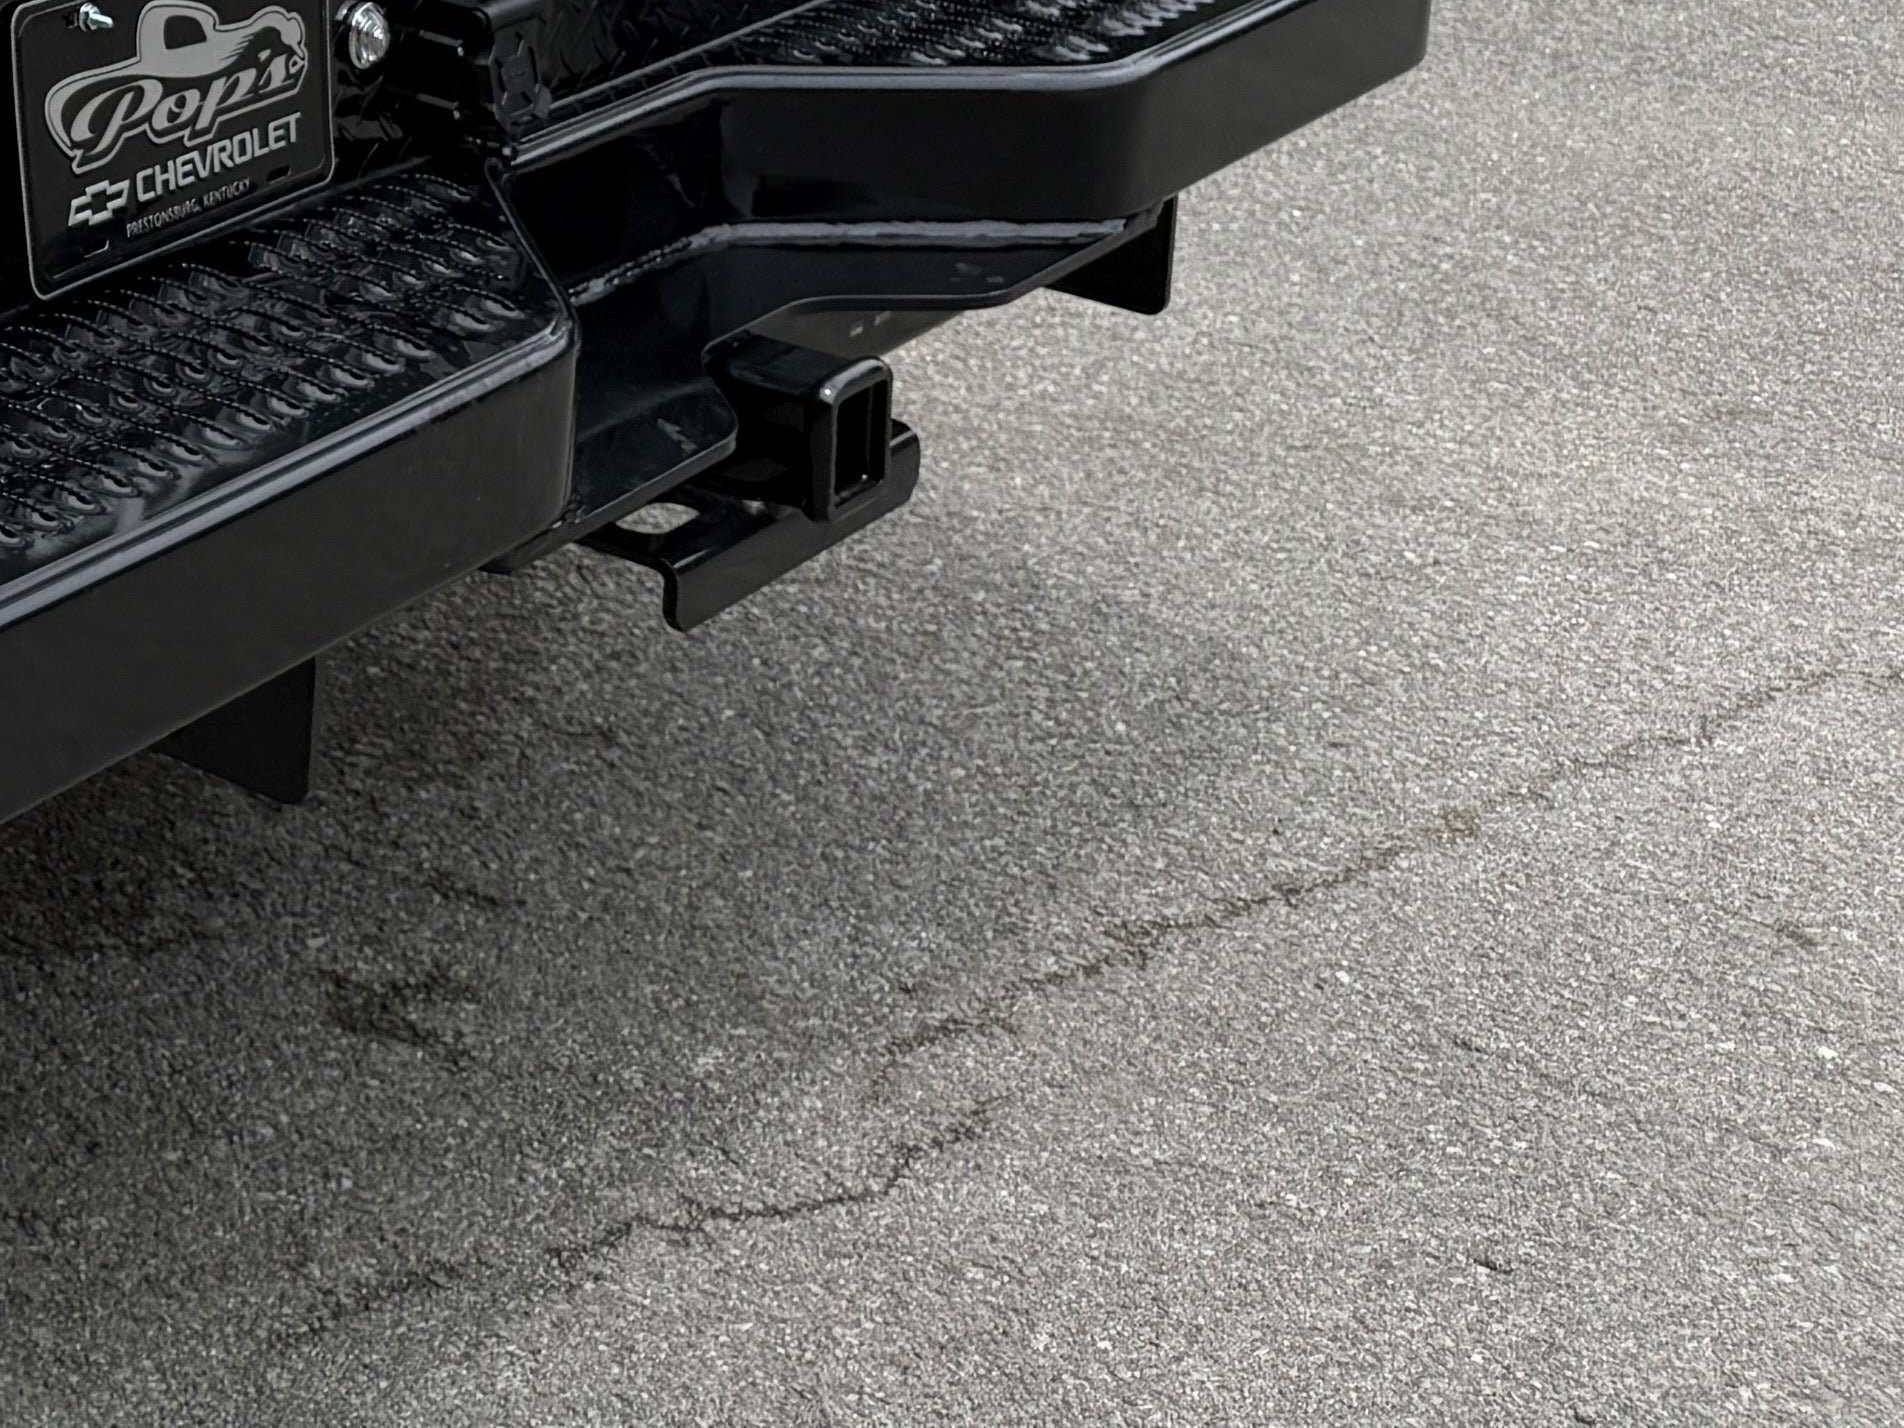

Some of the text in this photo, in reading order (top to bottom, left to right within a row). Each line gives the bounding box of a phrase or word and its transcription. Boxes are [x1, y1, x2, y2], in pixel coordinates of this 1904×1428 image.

[70, 48, 298, 154] Pop's
[136, 111, 302, 203] CHEVROLET
[202, 176, 251, 208] KENTUCKY
